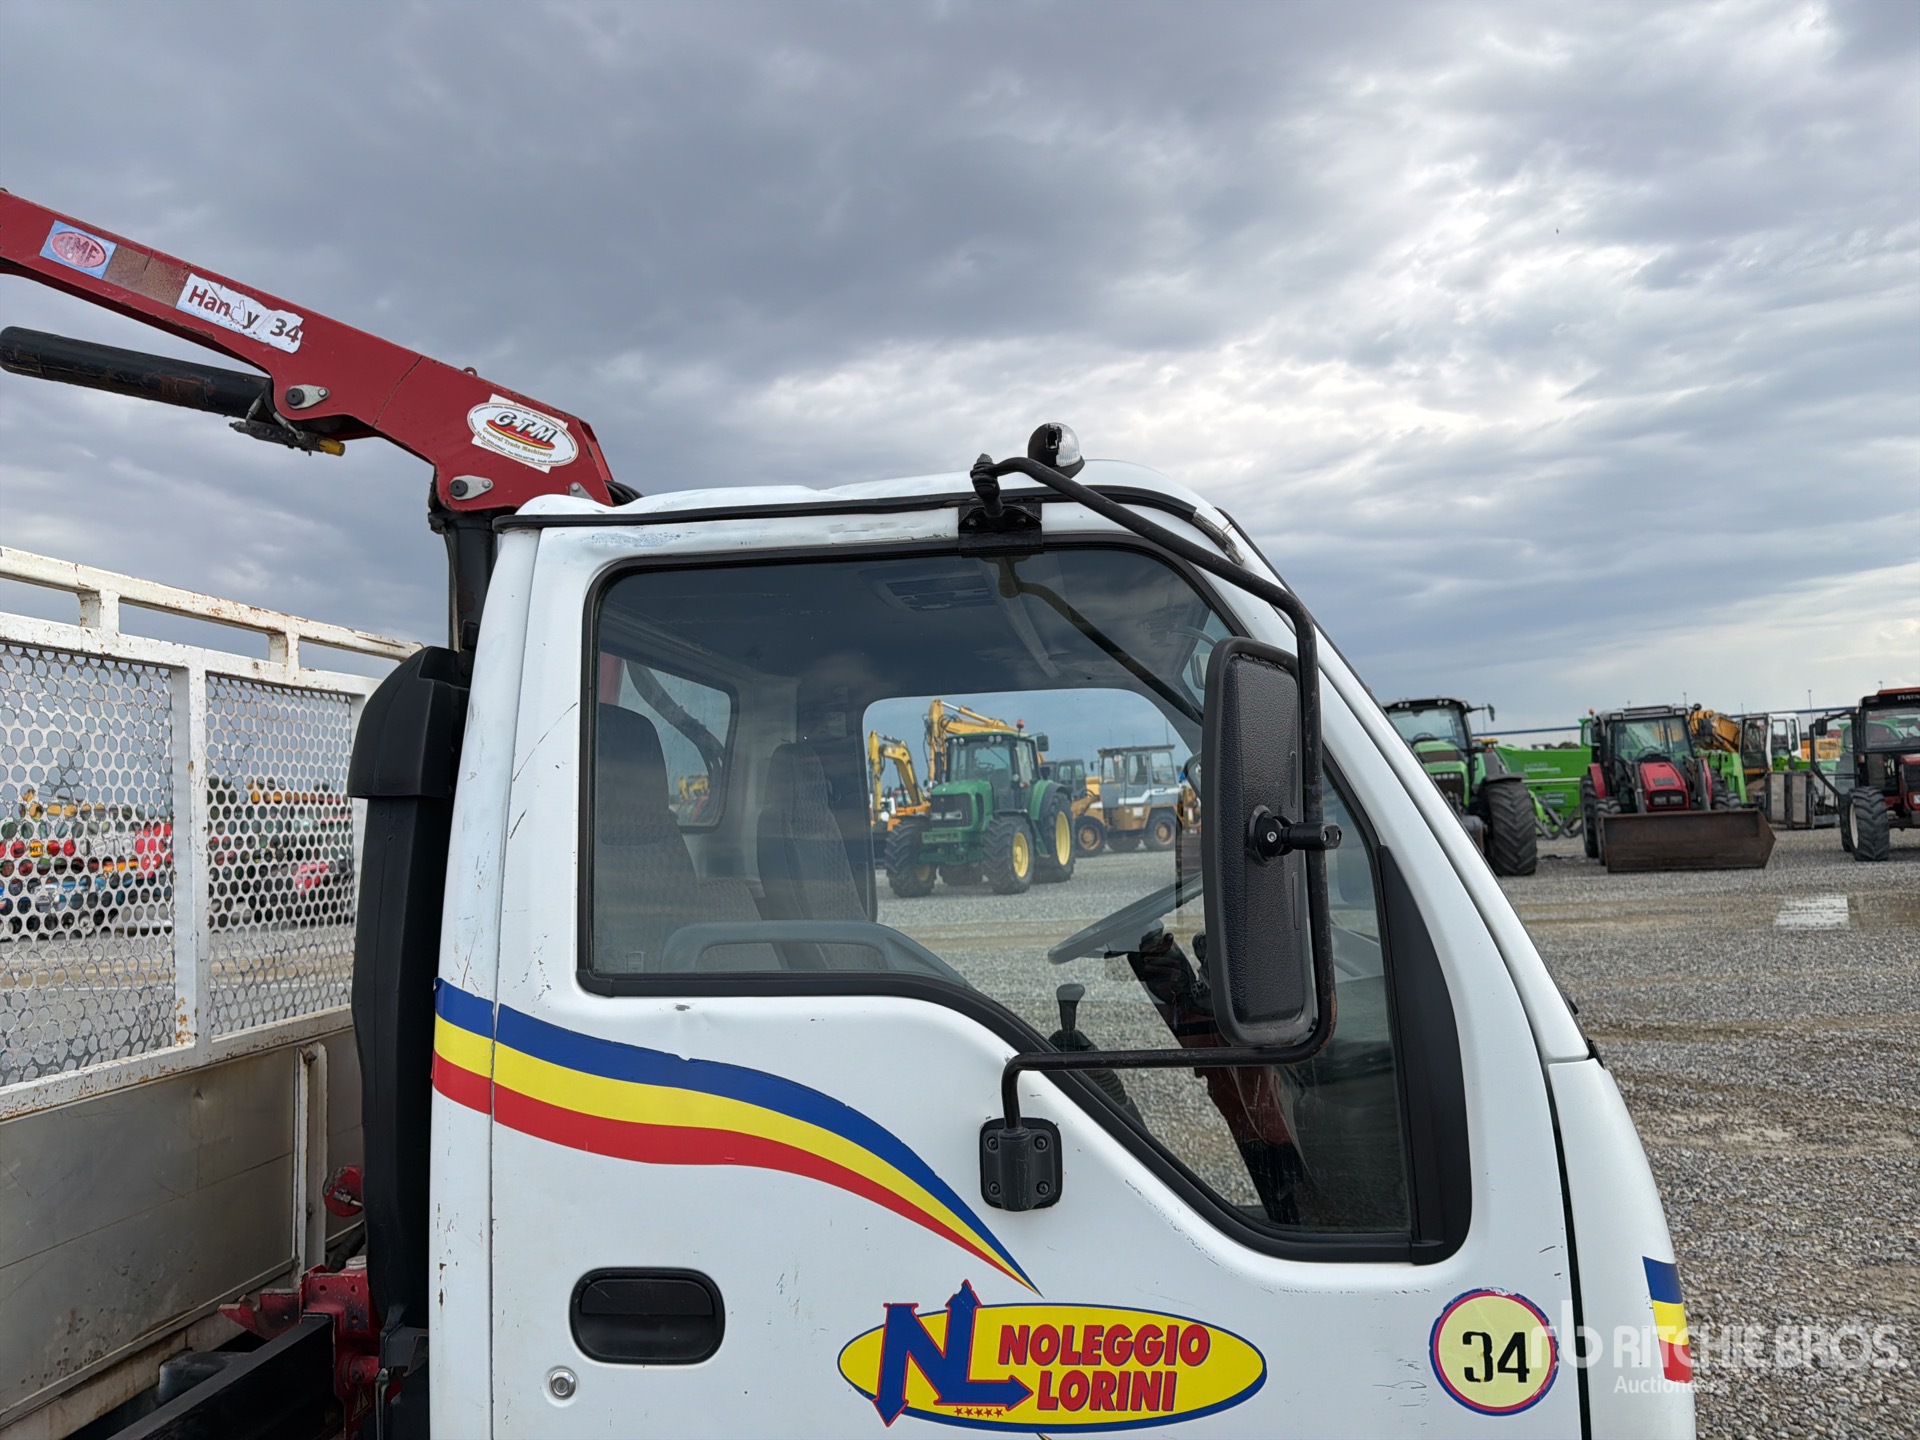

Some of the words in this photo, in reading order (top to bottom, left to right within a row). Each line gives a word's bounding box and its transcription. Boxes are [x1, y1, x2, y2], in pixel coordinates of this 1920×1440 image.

[270, 318, 299, 343] 34
[483, 427, 504, 443] General
[505, 439, 521, 449] Trade
[522, 445, 552, 458] Machinery
[494, 411, 558, 443] GTM
[998, 1323, 1210, 1366] NOLEGGIO
[1462, 1331, 1530, 1383] 34
[1037, 1370, 1177, 1412] LORINI
